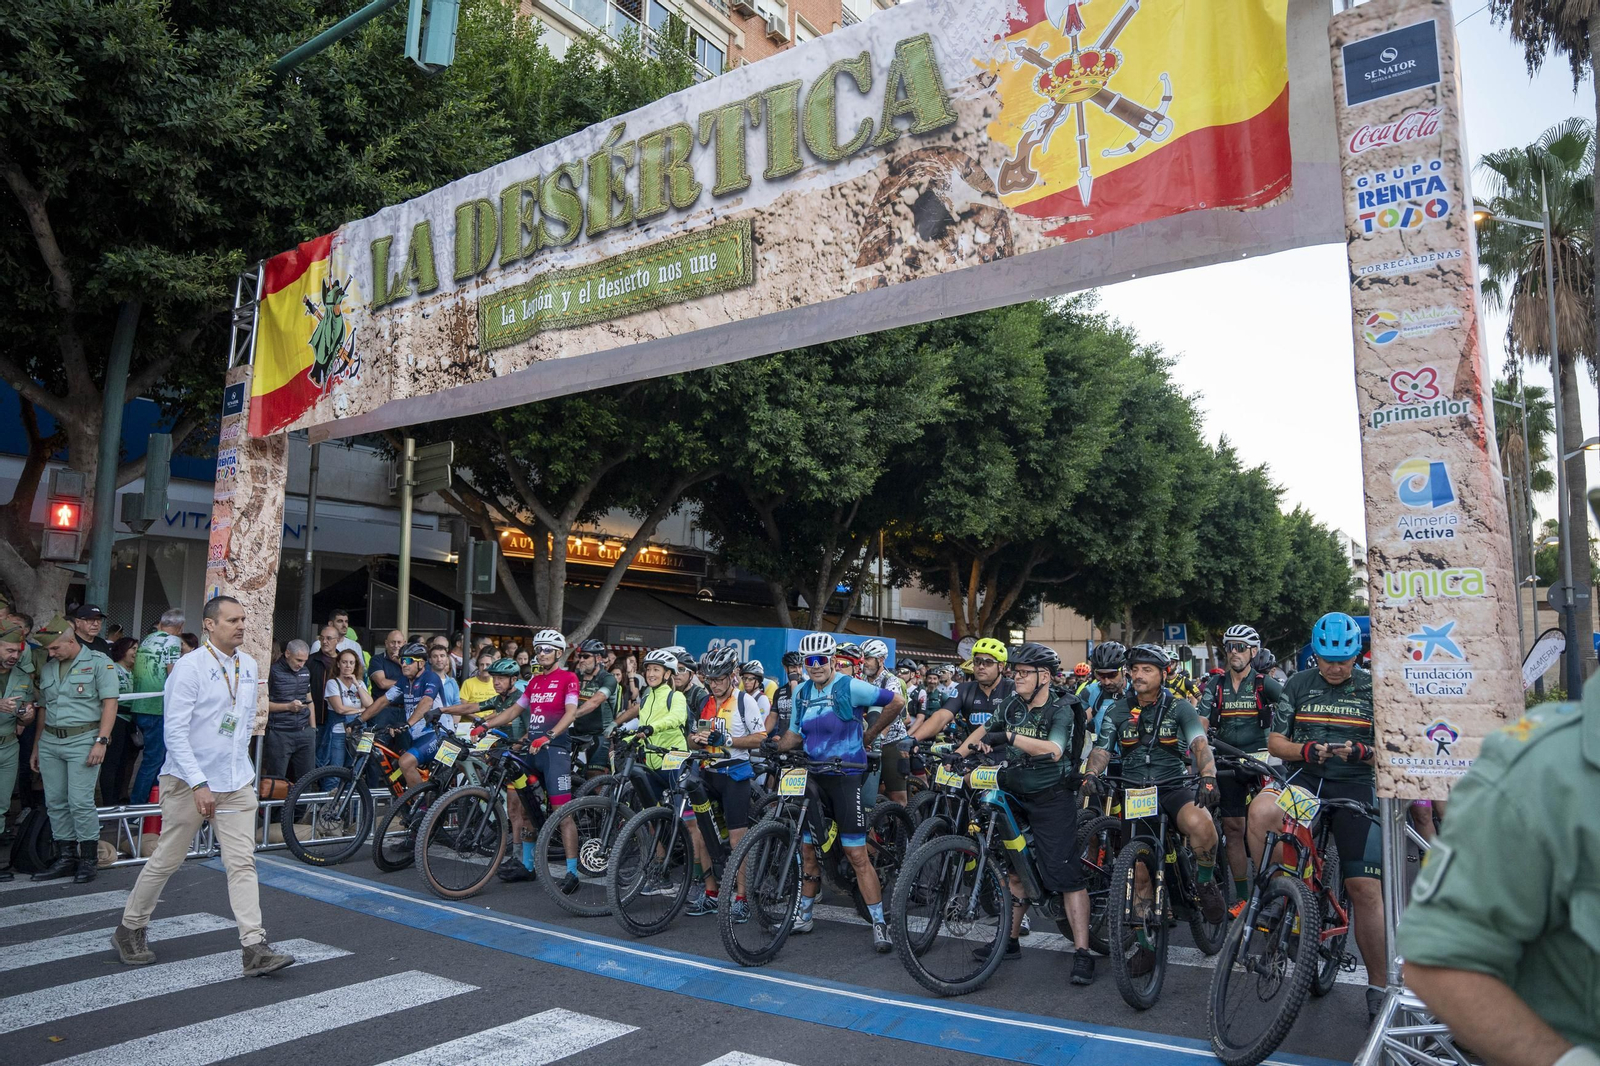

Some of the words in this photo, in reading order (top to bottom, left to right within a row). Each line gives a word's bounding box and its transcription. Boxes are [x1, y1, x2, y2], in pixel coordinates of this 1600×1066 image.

[1364, 59, 1417, 80] SENATOR
[1392, 69, 1412, 78] RESORTS
[1350, 109, 1443, 153] Coca-Cola
[370, 219, 439, 311] LA
[454, 32, 959, 283] DESÉRTICA
[1357, 160, 1442, 188] GRUPO
[1358, 175, 1448, 209] RENTA
[1359, 198, 1449, 233] TODO
[1360, 249, 1462, 275] TORRECARDENAS
[501, 305, 516, 326] La
[522, 290, 553, 320] Legión
[562, 291, 572, 312] y
[579, 281, 591, 304] el
[599, 270, 651, 299] desierto
[658, 260, 683, 284] nos
[689, 252, 718, 275] une
[1372, 399, 1470, 429] primaflor
[1397, 513, 1458, 528] Almería
[1402, 527, 1455, 541] Activa
[598, 546, 622, 560] CLU
[1168, 625, 1181, 639] P
[1404, 668, 1473, 680] Fundación
[1312, 702, 1362, 716] DESÉRTICA
[1391, 757, 1474, 767] COSTADEALME
[785, 777, 805, 787] 10052
[976, 770, 997, 781] 10077
[1132, 796, 1157, 809] 10163
